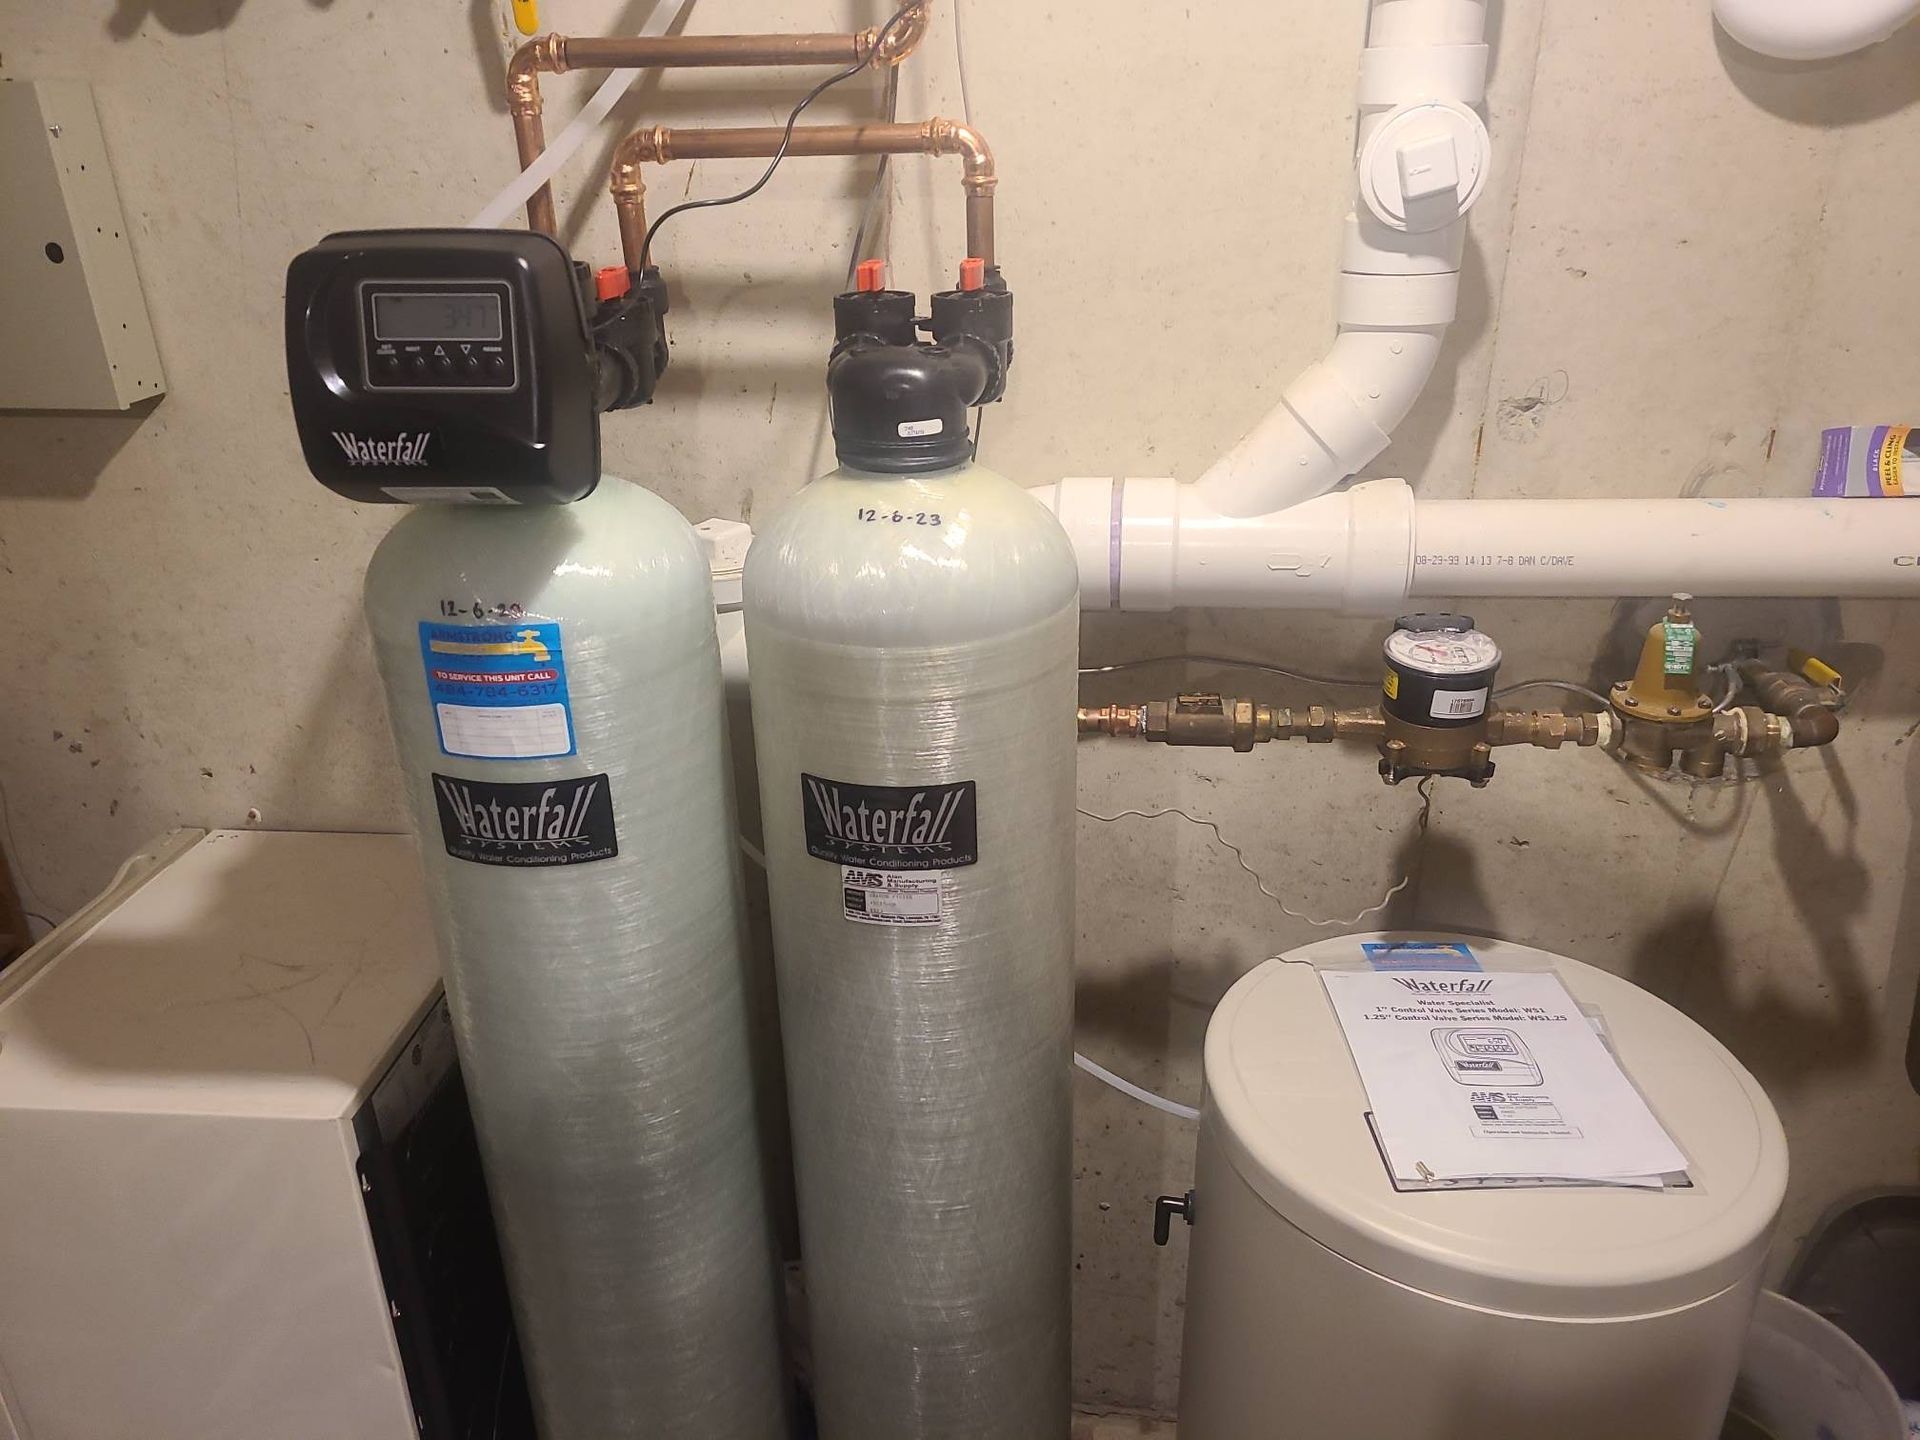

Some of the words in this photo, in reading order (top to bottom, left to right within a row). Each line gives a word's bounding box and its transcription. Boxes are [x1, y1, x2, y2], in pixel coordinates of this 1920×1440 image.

[331, 432, 431, 462] Waterfall
[1885, 434, 1897, 458] CLING
[1872, 448, 1880, 472] BLACK
[1885, 467, 1893, 486] PEEL
[858, 508, 942, 526] 12-6-23
[1518, 555, 1536, 566] DAN
[1540, 555, 1575, 566] C/DAVE
[436, 671, 447, 679] TO
[449, 672, 483, 682] SERVICE
[483, 673, 504, 682] THIS
[504, 673, 525, 682] UNIT
[527, 671, 552, 680] CALL
[438, 778, 598, 840] Waterfall
[807, 778, 966, 844] Waterfall
[479, 854, 503, 863] Water
[506, 854, 567, 865] Conditioning
[570, 847, 612, 861] Products
[841, 854, 866, 864] Water
[869, 857, 929, 868] Conditioning
[932, 853, 972, 866] Products
[844, 869, 883, 887] AMS
[1392, 977, 1494, 993] Waterfall
[1447, 999, 1495, 1007] Specialist
[1395, 1014, 1431, 1022] Control
[1433, 1014, 1459, 1022] Valve
[1461, 1014, 1490, 1022] Series
[1493, 1014, 1527, 1022] Model:
[1527, 1014, 1568, 1022] WS1.25
